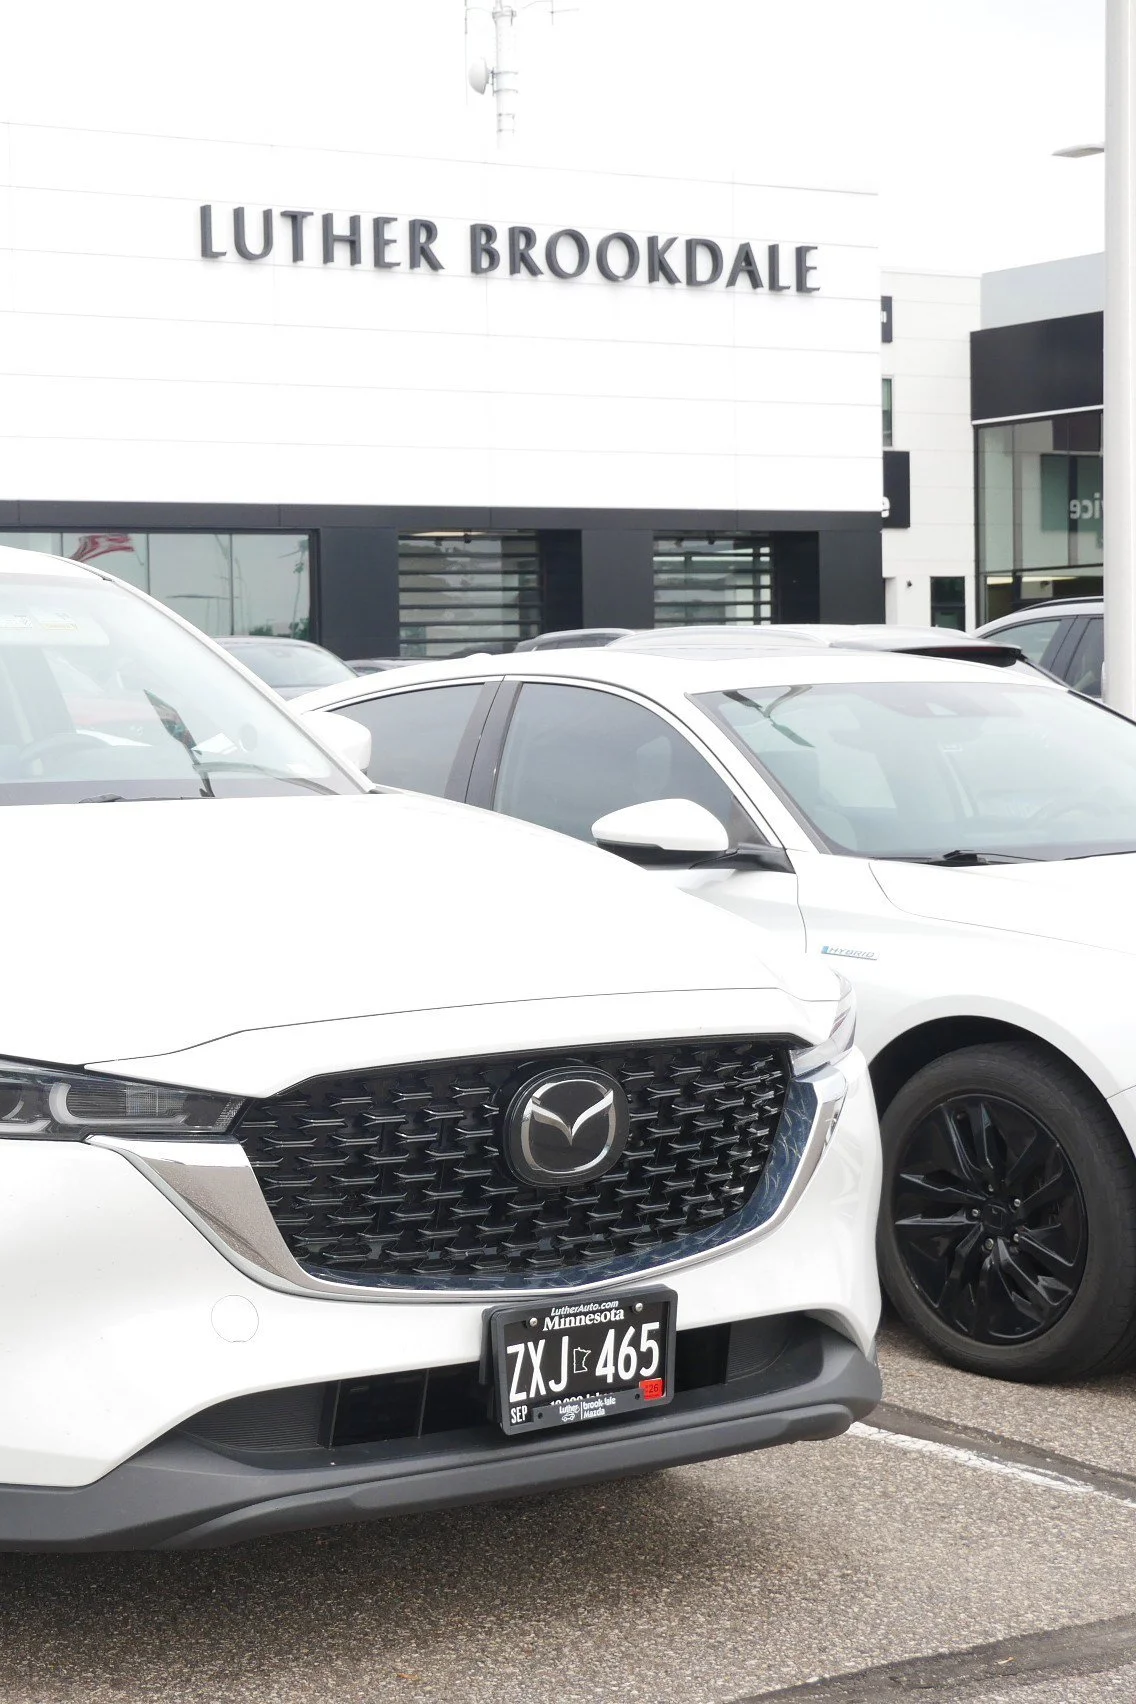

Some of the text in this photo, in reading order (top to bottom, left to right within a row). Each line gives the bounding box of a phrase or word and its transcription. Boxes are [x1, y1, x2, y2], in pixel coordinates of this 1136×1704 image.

[200, 204, 820, 294] LUTHER BROOKDALE
[828, 947, 876, 958] HYBRID
[550, 1300, 619, 1316] LutherAuto.com
[542, 1307, 624, 1332] Minnesota
[506, 1321, 660, 1403] ZXJ 465
[510, 1405, 528, 1424] SEP
[583, 1407, 606, 1419] Mazda
